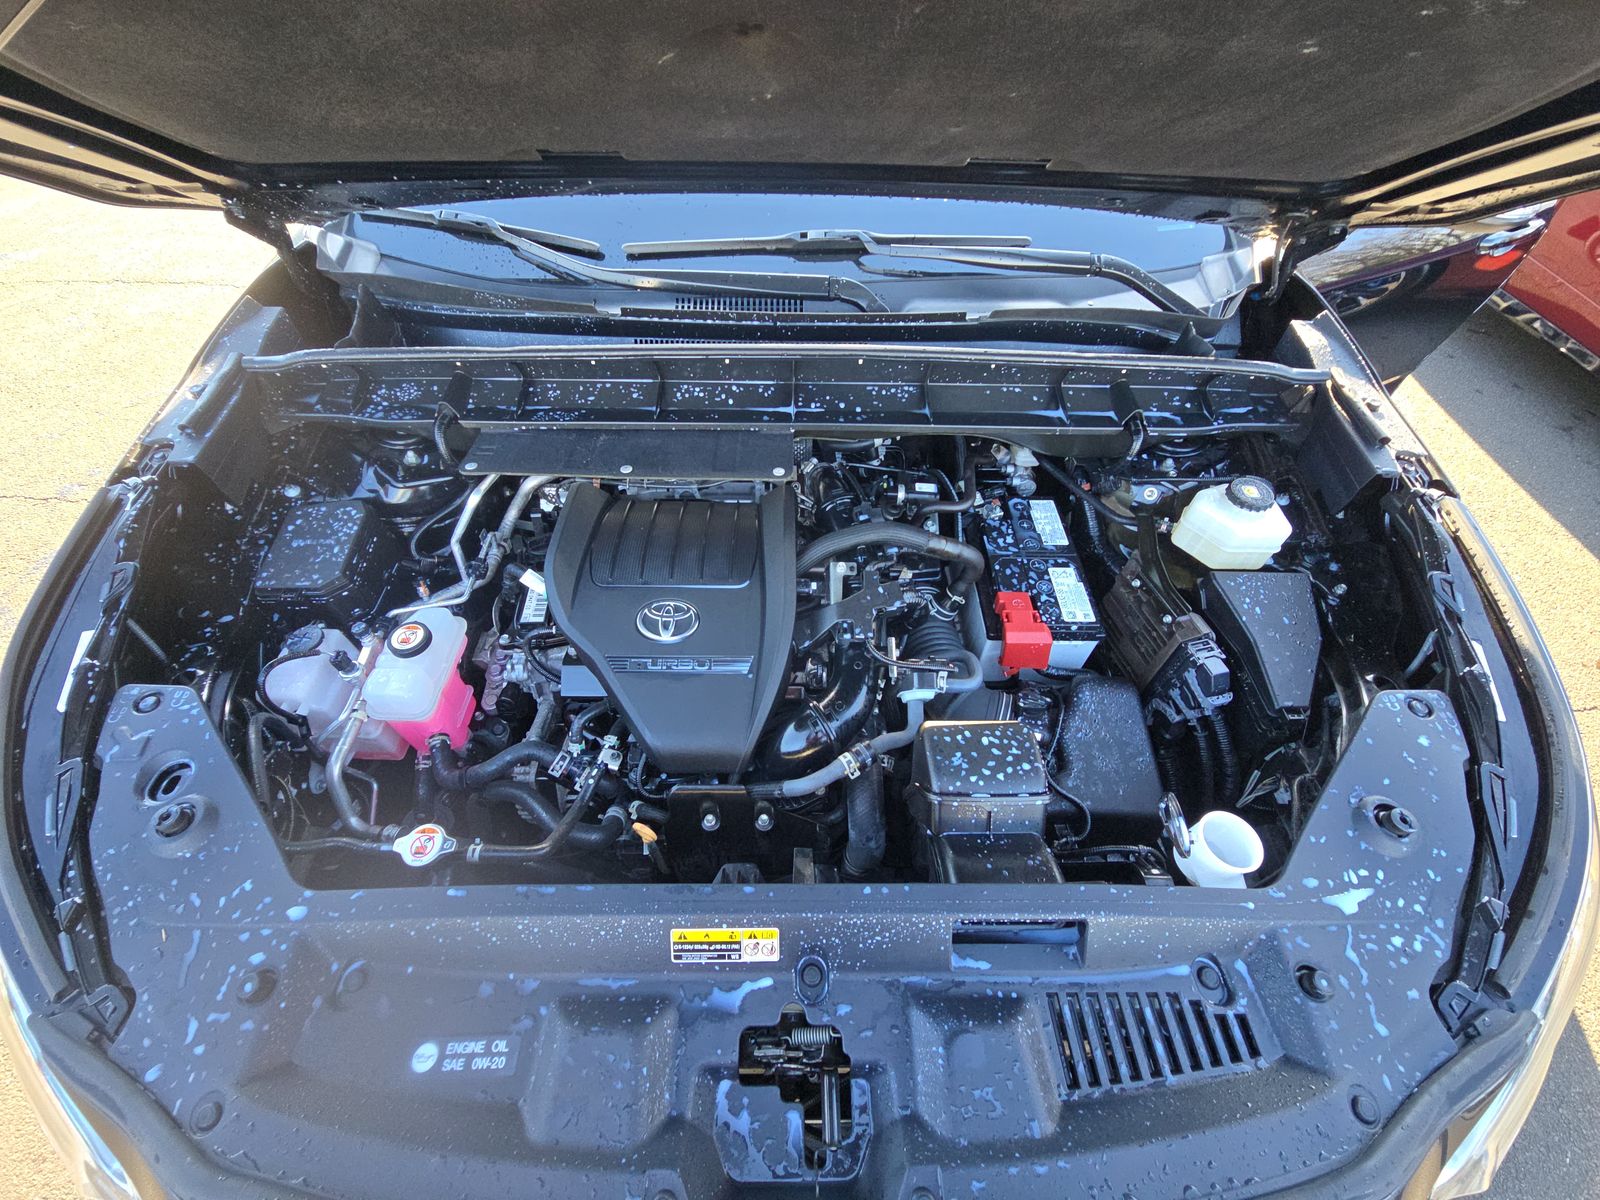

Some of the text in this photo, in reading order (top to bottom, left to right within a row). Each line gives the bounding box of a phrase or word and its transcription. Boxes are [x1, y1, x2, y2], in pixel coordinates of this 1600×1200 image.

[630, 658, 711, 670] TURBO
[446, 1040, 509, 1054] ENGINE OIL
[441, 1056, 505, 1071] SAE 0W-20
